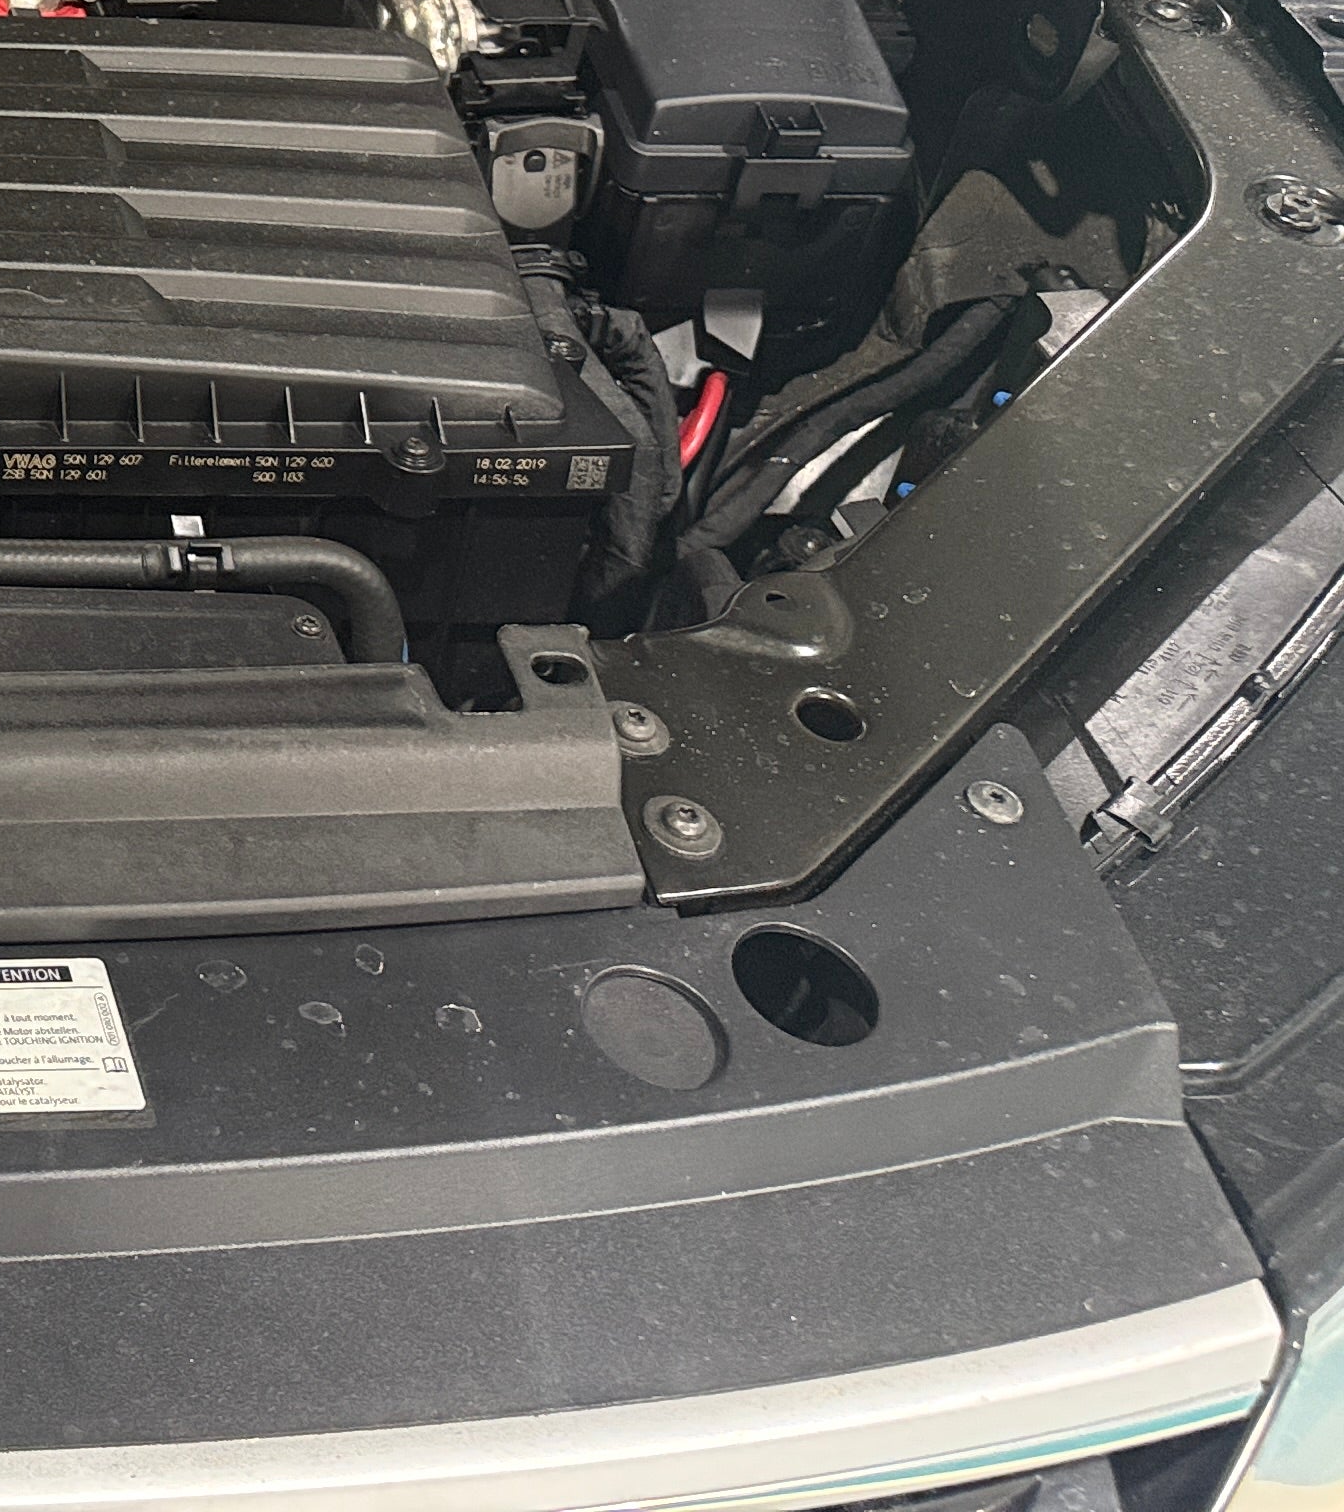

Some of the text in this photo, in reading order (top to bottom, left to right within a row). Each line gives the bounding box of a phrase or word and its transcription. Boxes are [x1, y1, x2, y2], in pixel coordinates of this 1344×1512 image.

[2, 453, 56, 469] VWAG
[93, 454, 115, 465] 129
[118, 454, 143, 466] 607
[169, 454, 251, 467] Filterelement
[285, 456, 307, 468] 129
[310, 456, 335, 468] 620
[60, 470, 82, 481] 129
[85, 470, 108, 481] 601
[473, 474, 530, 486] 14:56:56
[5, 1037, 57, 1045] TOUCHING
[59, 1036, 103, 1044] IGNITION
